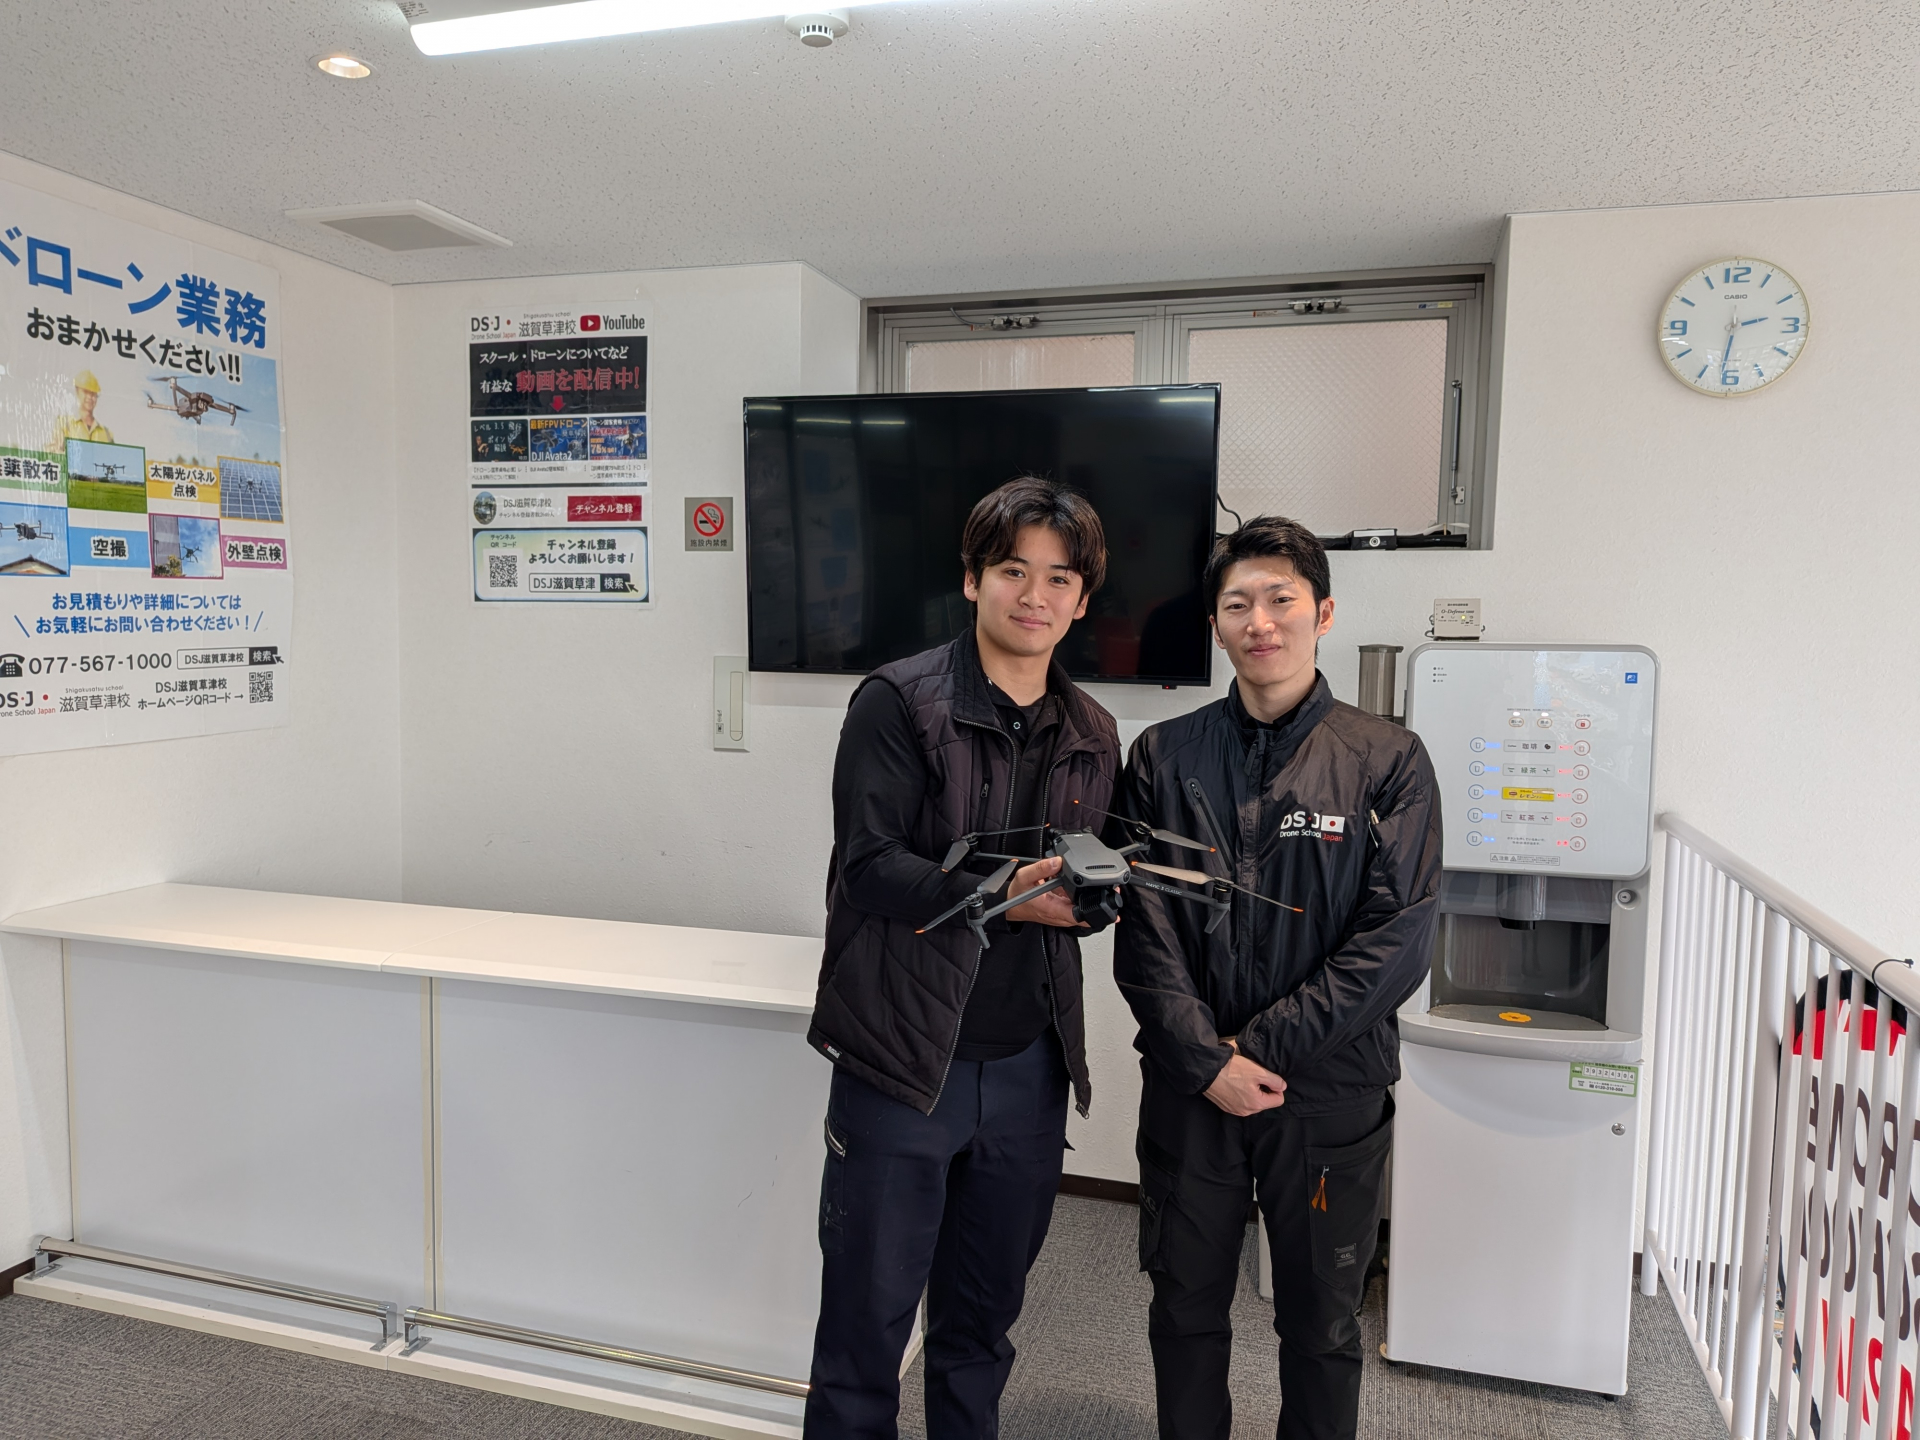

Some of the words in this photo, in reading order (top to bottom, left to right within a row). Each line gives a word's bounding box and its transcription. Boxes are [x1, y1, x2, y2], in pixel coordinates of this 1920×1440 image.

[1723, 266, 1751, 283] 12
[519, 320, 577, 338] 滋賀草津校
[603, 314, 645, 331] YouTube
[1670, 320, 1688, 336] 9
[1781, 317, 1800, 333] 3
[479, 346, 629, 364] スクール・ドローンについてなど
[480, 379, 513, 393] 有益な
[1722, 370, 1740, 386] 6
[531, 452, 544, 461] DJI
[545, 451, 572, 461] Avata2
[0, 458, 59, 482] 薬散布
[150, 465, 215, 483] 太陽光パネル
[173, 484, 197, 498] 点検
[576, 503, 633, 515] チャンネル登録
[92, 537, 127, 558] 空撮
[547, 539, 616, 551] チャンネル登録
[690, 539, 728, 547] 施設内禁煙
[227, 542, 283, 562] 外壁点検
[533, 577, 596, 590] DSJ滋賀草津
[604, 578, 624, 589] 検索
[52, 592, 242, 611] お見積もりや詳細については
[28, 653, 172, 675] 077-567-1000
[184, 652, 244, 665] DSJ滋賀草津校
[253, 651, 272, 663] 検索
[155, 678, 228, 694] DSJ滋賀草津校
[59, 693, 131, 713] 滋賀草津校
[15, 708, 36, 717] School
[1280, 829, 1299, 838] Drone
[1301, 829, 1322, 838] School
[1322, 833, 1343, 842] Japan
